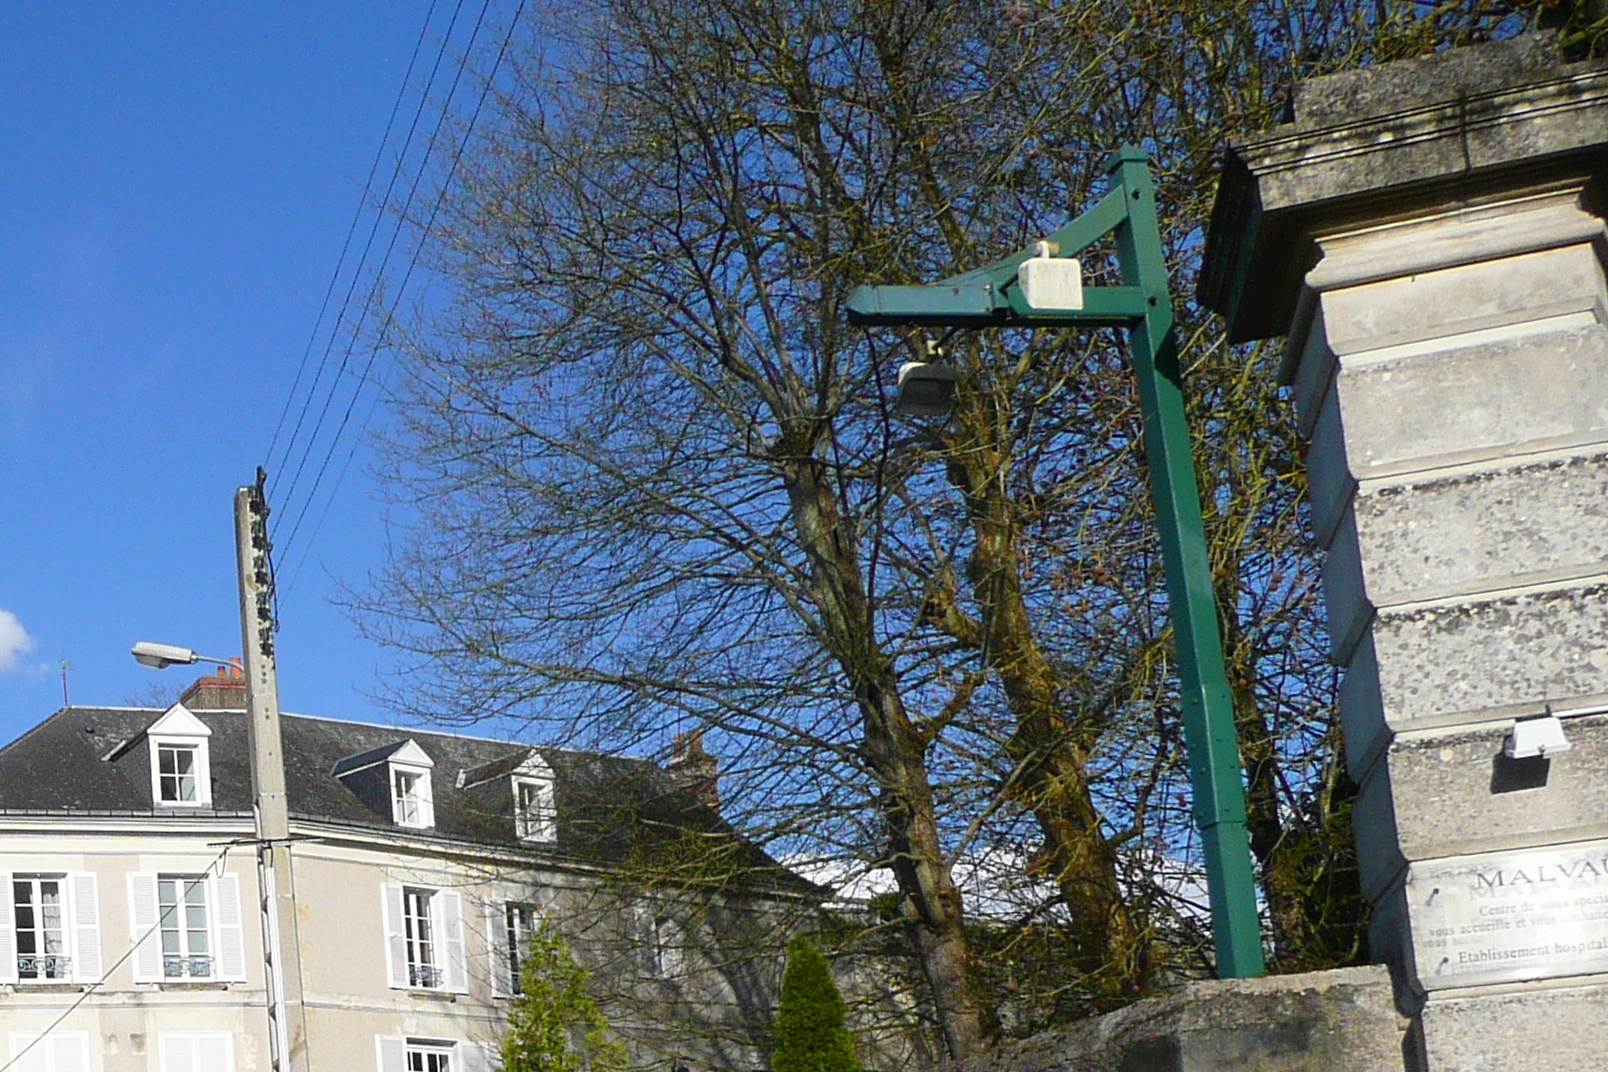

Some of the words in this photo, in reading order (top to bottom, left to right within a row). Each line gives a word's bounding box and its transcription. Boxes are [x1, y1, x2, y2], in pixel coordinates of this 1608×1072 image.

[1479, 905, 1517, 916] Centre
[1521, 901, 1534, 912] de
[1429, 926, 1455, 937] vous
[1460, 919, 1511, 935] accueille
[1516, 919, 1527, 929] et
[1531, 916, 1556, 926] vous
[1459, 945, 1550, 964] Etablissement
